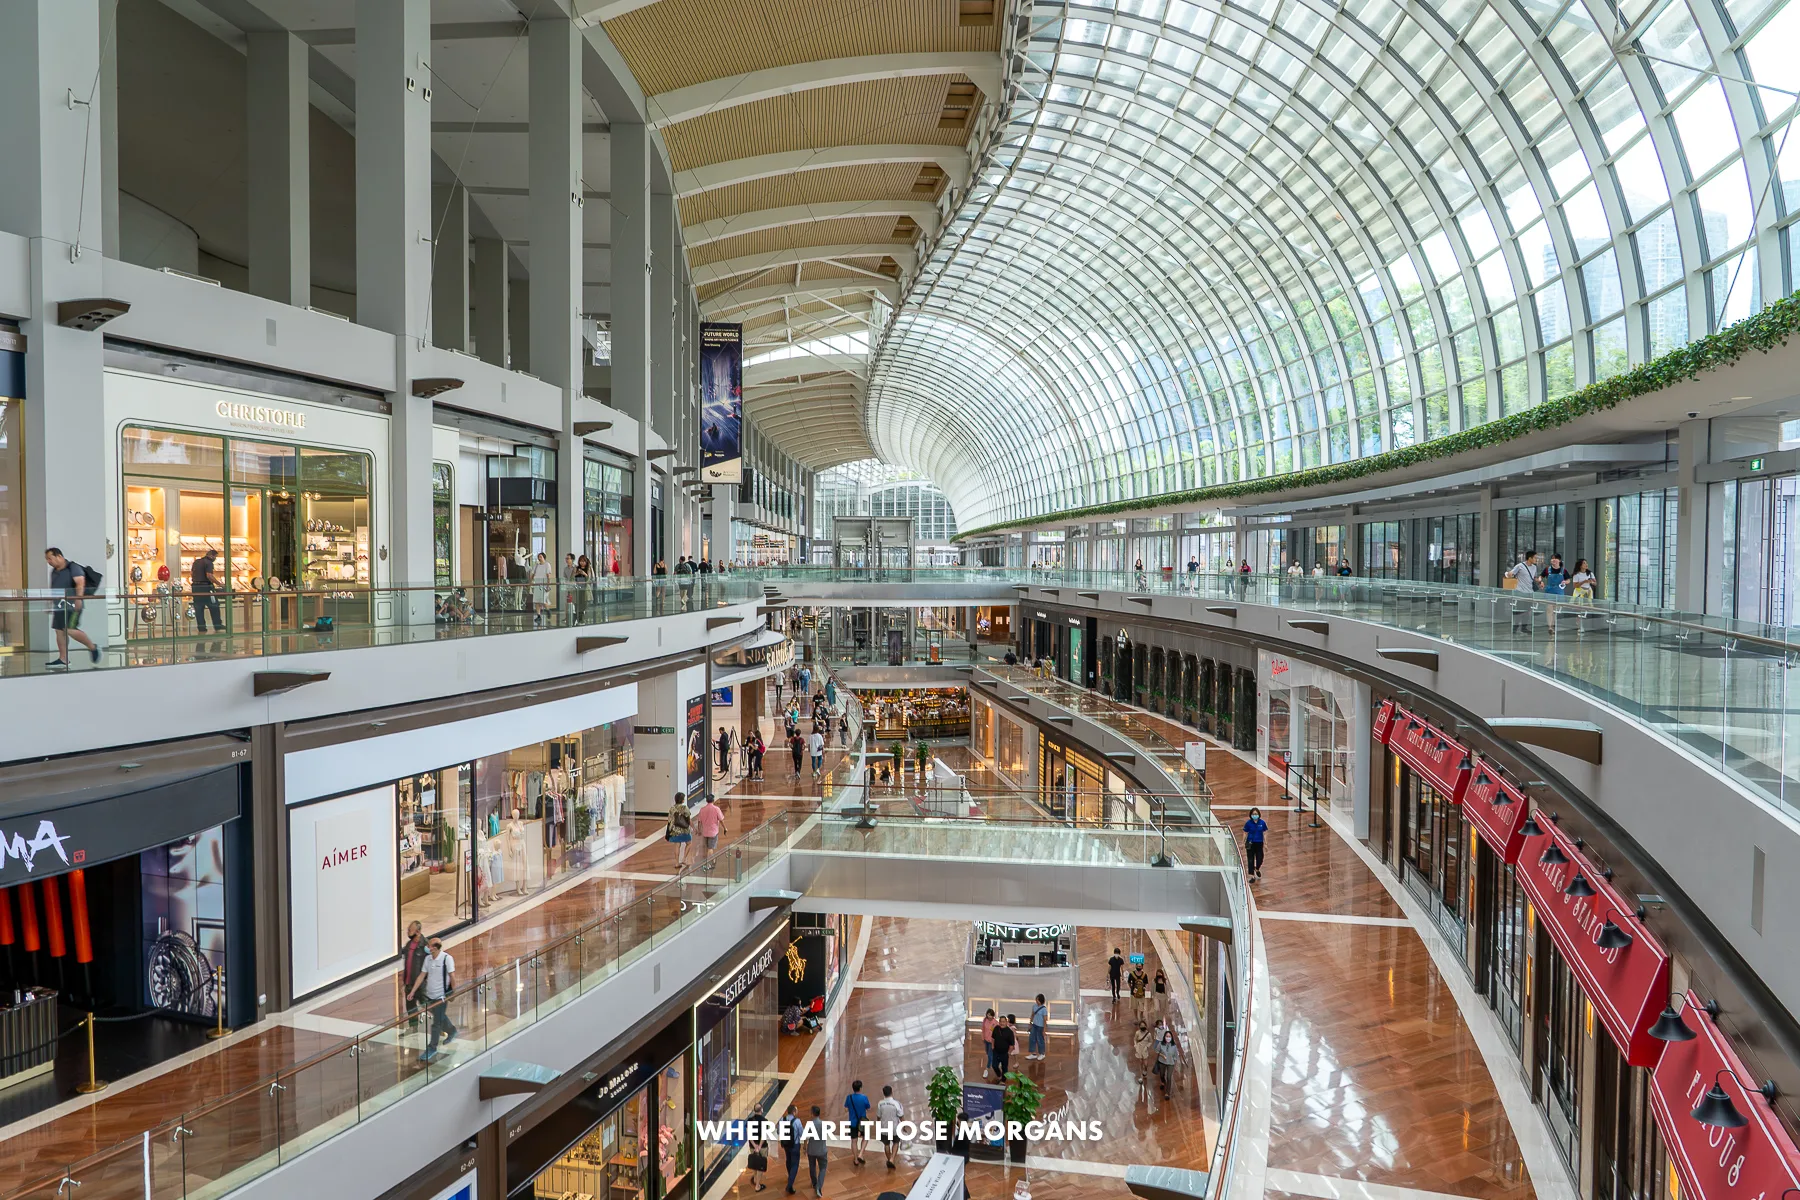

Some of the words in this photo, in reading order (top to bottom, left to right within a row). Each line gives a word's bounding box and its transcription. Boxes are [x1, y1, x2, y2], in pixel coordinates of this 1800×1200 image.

[216, 401, 307, 428] CHRISTOFLE
[231, 749, 247, 758] B1-67
[322, 844, 368, 870] AÍMER
[1572, 896, 1619, 965] SEAFOD
[746, 948, 773, 984] LAUDER
[610, 1082, 628, 1099] LONDON
[1686, 1070, 1745, 1187] FAOUS
